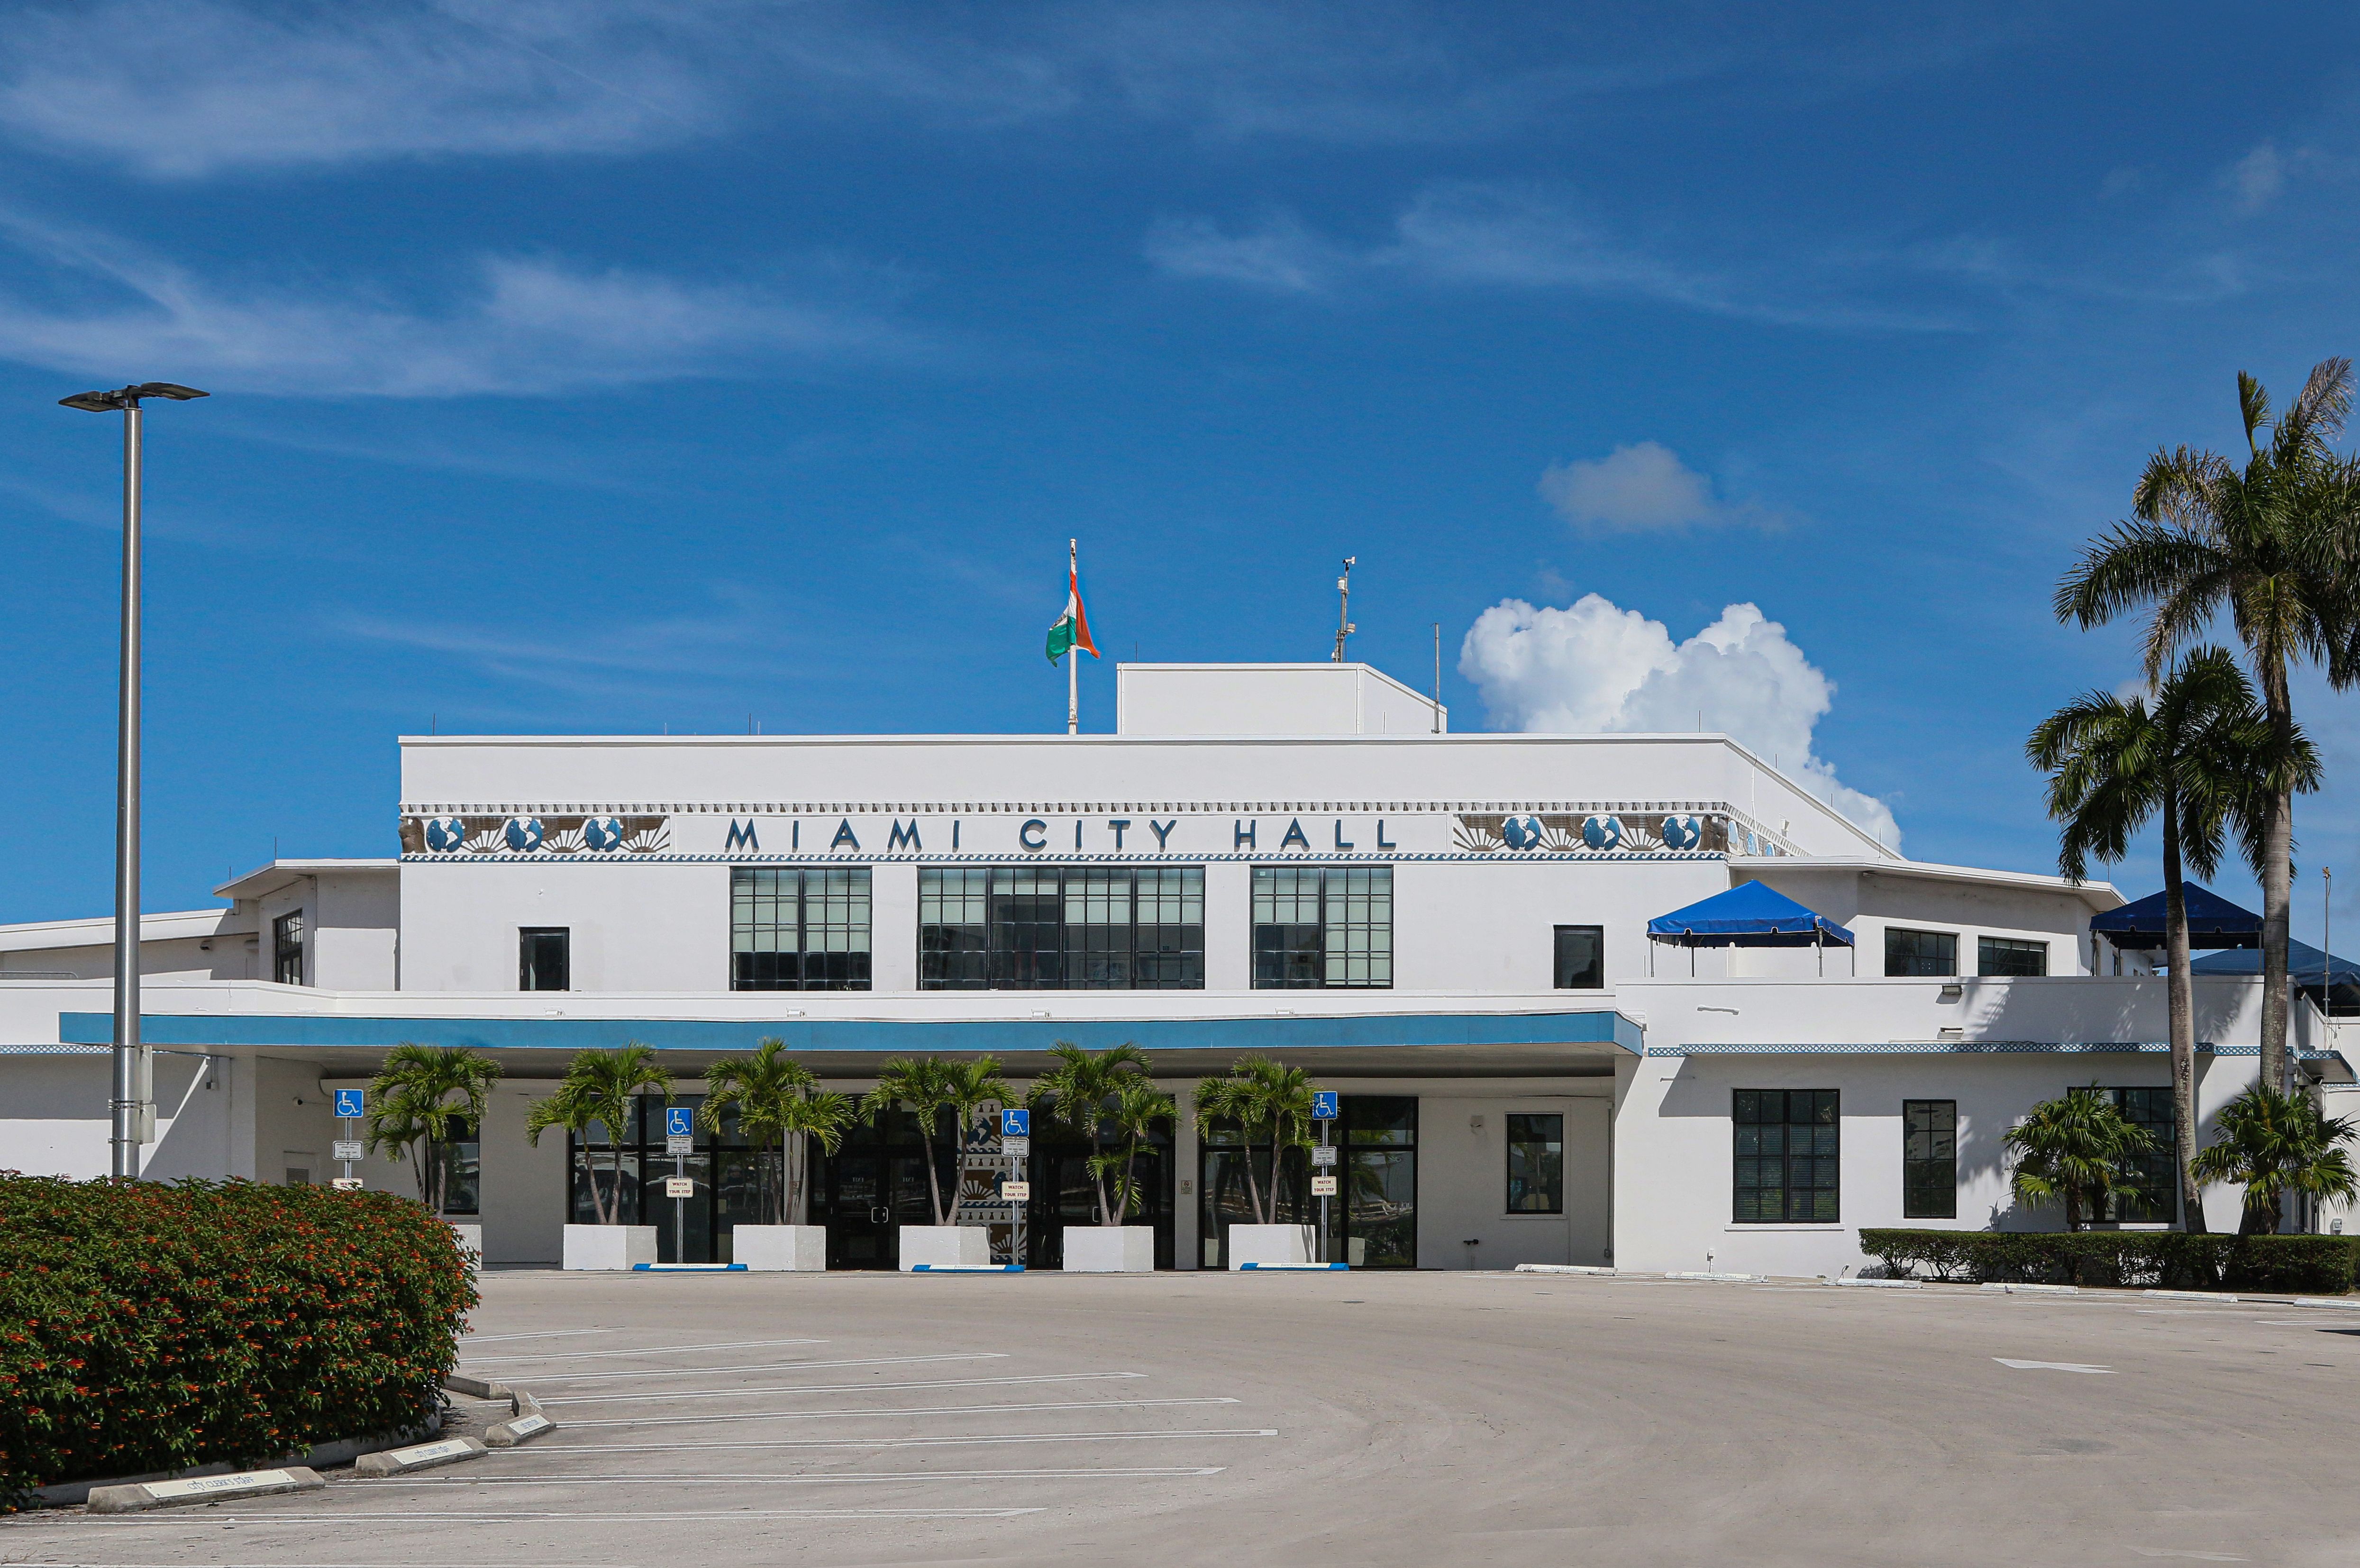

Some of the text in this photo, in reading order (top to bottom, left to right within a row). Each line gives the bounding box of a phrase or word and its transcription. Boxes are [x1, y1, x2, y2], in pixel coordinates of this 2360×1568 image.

[726, 818, 1397, 848] MIAMI CITY HALL
[187, 1481, 206, 1490] CITY
